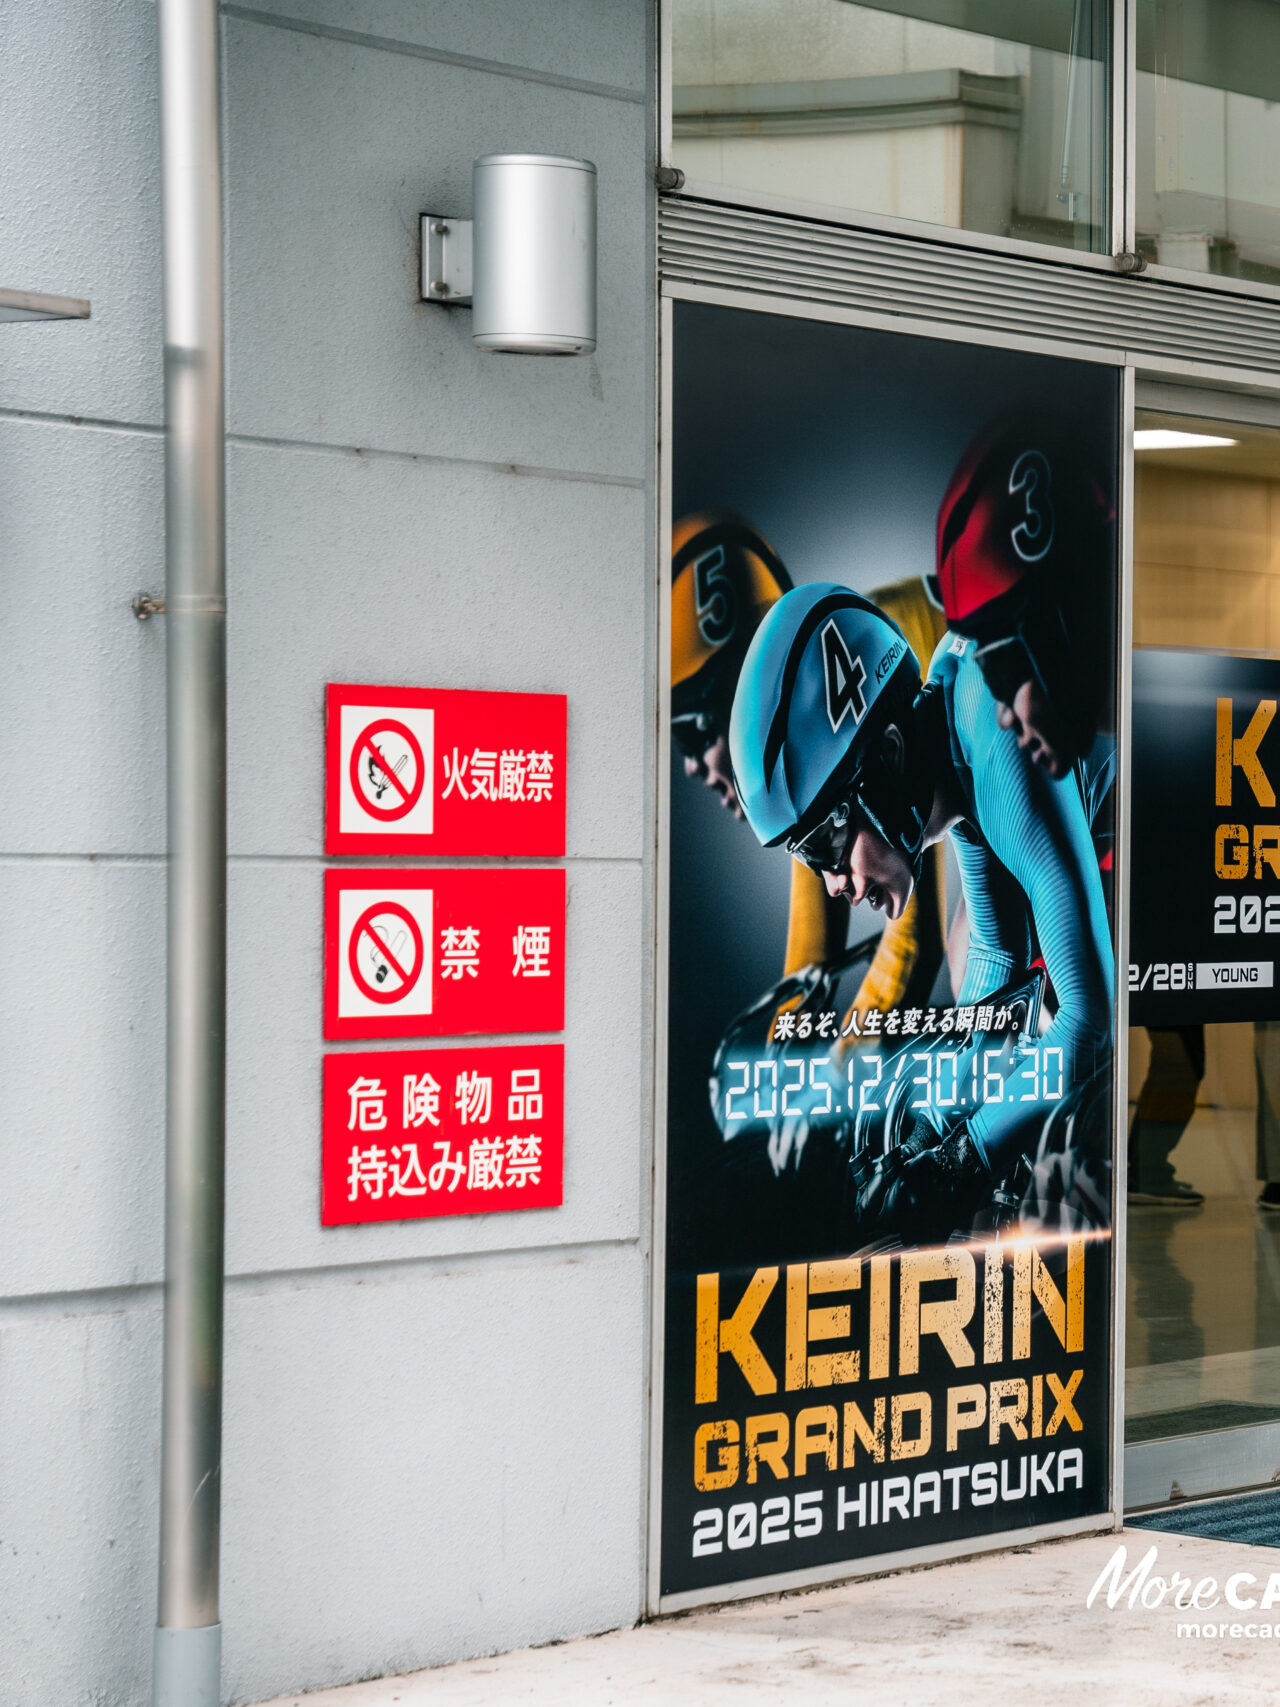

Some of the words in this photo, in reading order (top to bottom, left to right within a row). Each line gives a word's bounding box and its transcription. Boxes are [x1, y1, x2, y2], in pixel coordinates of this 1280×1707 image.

[1008, 449, 1055, 562] 3
[693, 544, 738, 646] 5
[820, 618, 868, 734] 4
[875, 638, 904, 685] KEIRIN
[441, 746, 554, 803] 火気厳禁
[440, 925, 552, 981] 禁煙
[1129, 963, 1186, 992] 2/28
[1212, 967, 1259, 984] YOUNG
[773, 1004, 1020, 1041] 来るぞ、人生を変える瞬間が。
[346, 1068, 544, 1132] 危険物品
[347, 1135, 543, 1202] 持込み厳禁
[695, 1232, 1086, 1405] KEIRIN
[693, 1391, 933, 1492] GRAND
[946, 1369, 1085, 1453] PRIX
[692, 1490, 824, 1558] 2025
[837, 1447, 1084, 1532] HIRATSUKA
